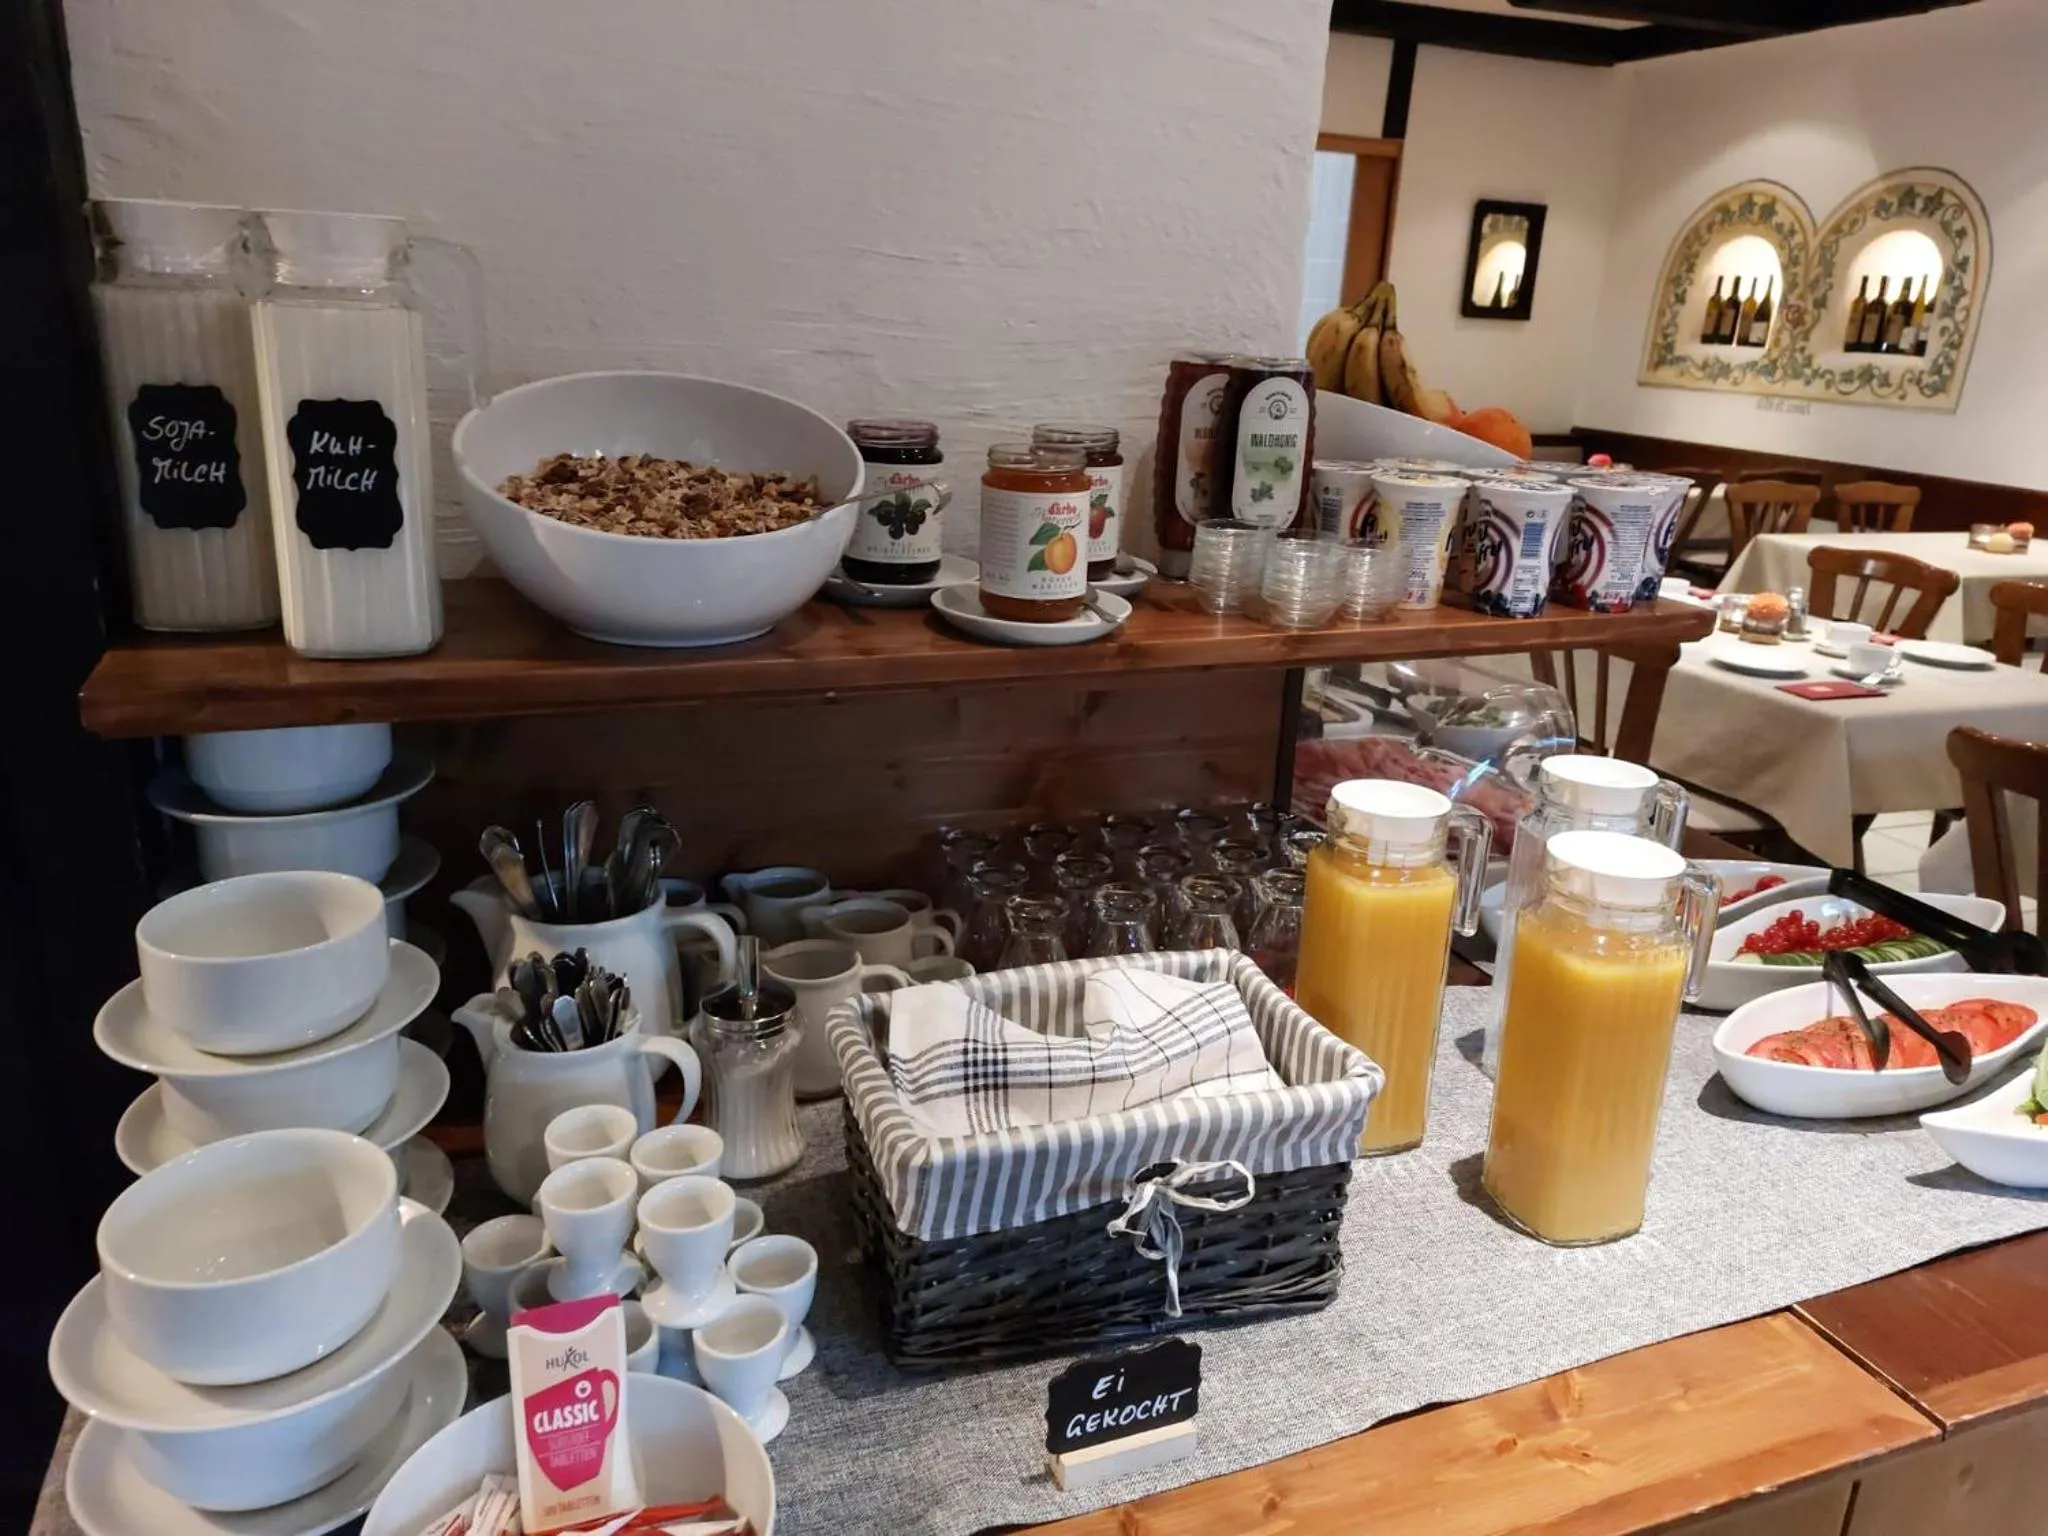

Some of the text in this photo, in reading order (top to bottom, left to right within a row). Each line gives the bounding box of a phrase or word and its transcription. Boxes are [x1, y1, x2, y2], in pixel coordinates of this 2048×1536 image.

[546, 1346, 591, 1372] HUXOL
[1092, 1367, 1125, 1400] Ei
[532, 1400, 600, 1434] CLASSIC
[1065, 1387, 1193, 1439] GEKOCHT
